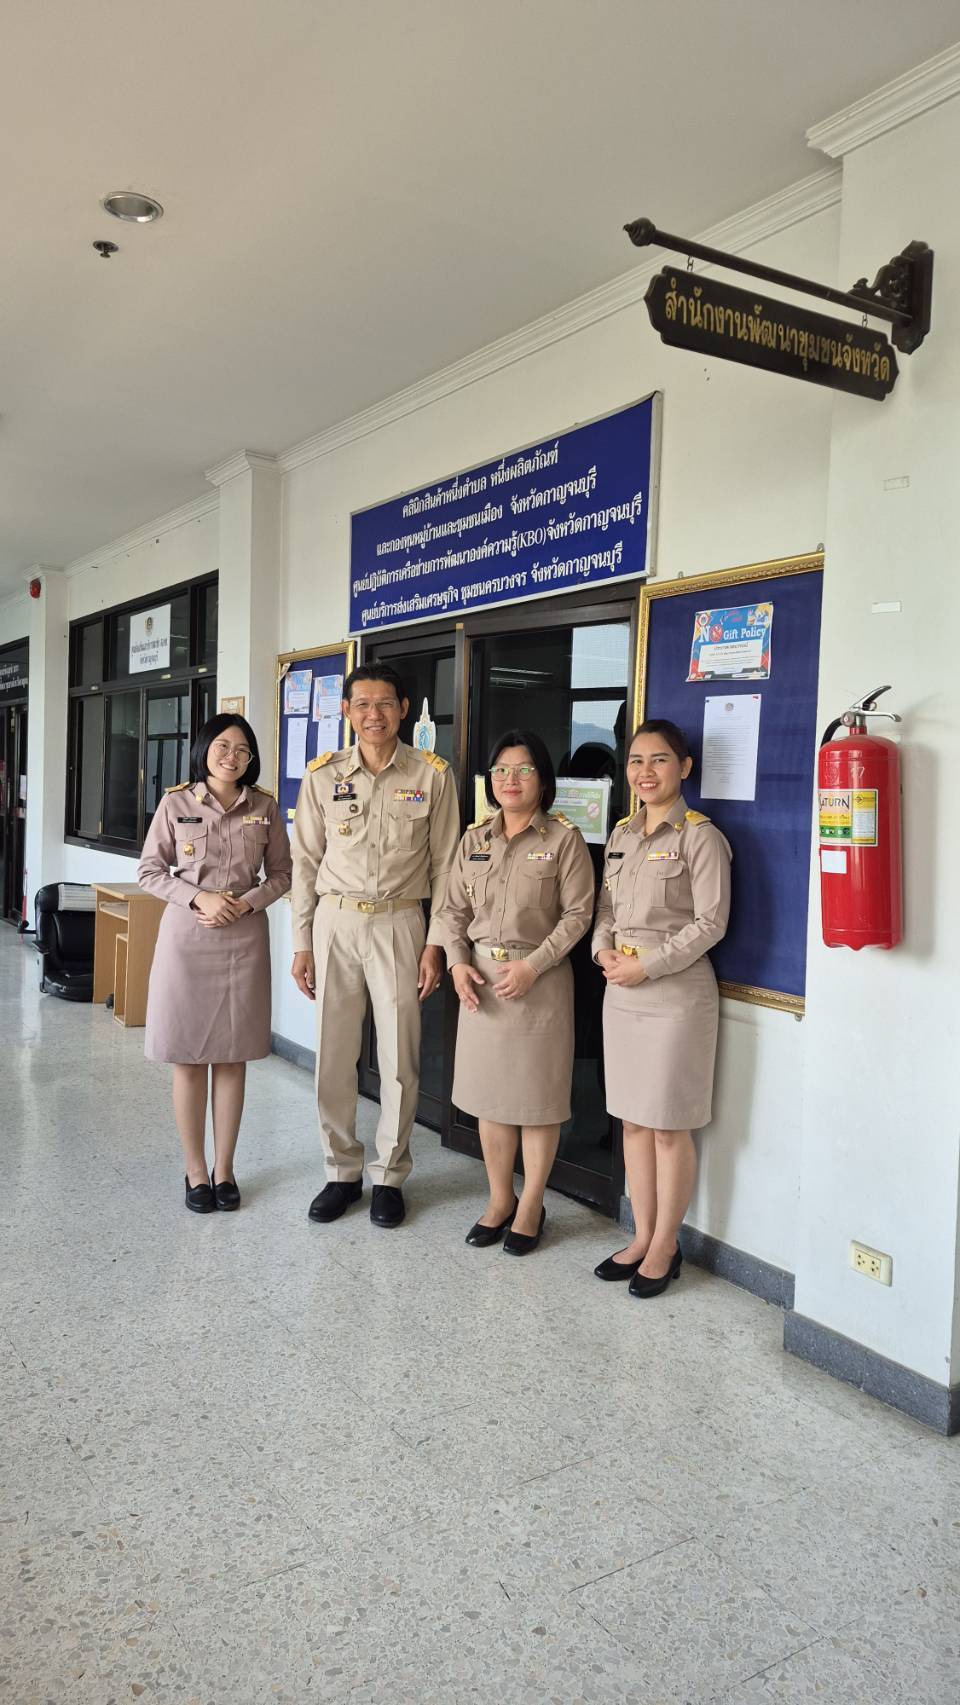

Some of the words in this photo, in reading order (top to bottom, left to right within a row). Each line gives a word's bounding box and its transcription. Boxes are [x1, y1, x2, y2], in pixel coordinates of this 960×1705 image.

[664, 277, 890, 382] สำนักงานพัฒนาชุมชนจังหวัด
[402, 475, 487, 518] คลินิกสินค้าหนึ่งตำบล
[490, 441, 560, 489] หนึ่งผลิตภัณฑ์
[510, 465, 597, 515] จังหวัดกาญจนบุรี
[461, 571, 527, 605] ชุมชนครบวงจร
[531, 541, 623, 583] จังหวัดกาญจนบุรี
[723, 629, 738, 640] Gift
[741, 626, 767, 639] Policy
